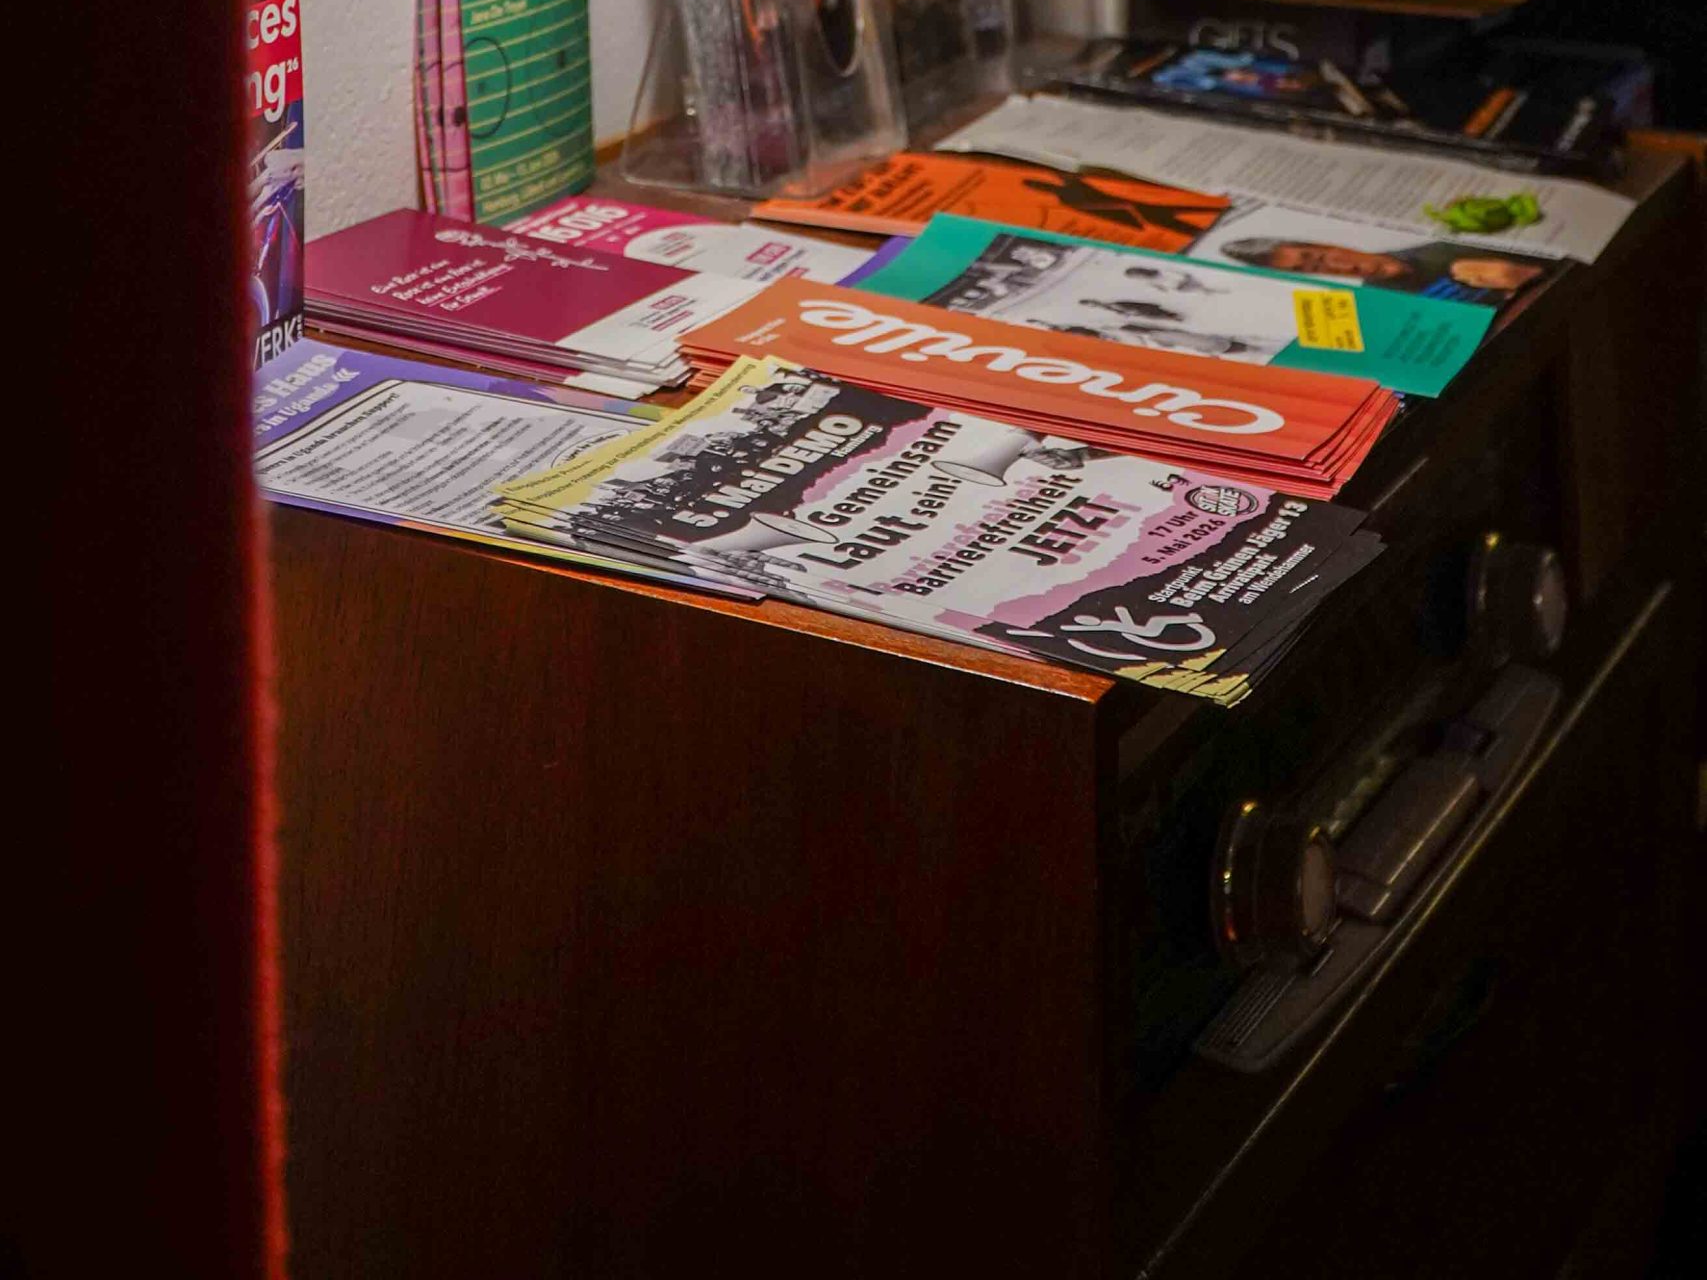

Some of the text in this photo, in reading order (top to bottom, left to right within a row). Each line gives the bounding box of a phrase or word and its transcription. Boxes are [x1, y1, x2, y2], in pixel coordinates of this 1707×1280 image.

[264, 353, 338, 398] Haus
[799, 299, 1286, 435] Cineville
[672, 414, 864, 527] 5. Mai DEMO
[808, 420, 962, 527] Gemeinsam
[831, 424, 884, 458] Hamburg
[797, 475, 962, 570] Laut sein!
[893, 474, 1083, 596] Barrierefreiheit
[1008, 495, 1119, 566] JETZT
[1141, 518, 1227, 565] 5. Mai 2026
[1148, 509, 1201, 538] 17 Uhr
[1169, 500, 1310, 609] Beim Grünen Jäger 13
[1148, 564, 1204, 604] Startpunkt
[1238, 590, 1262, 606] am
